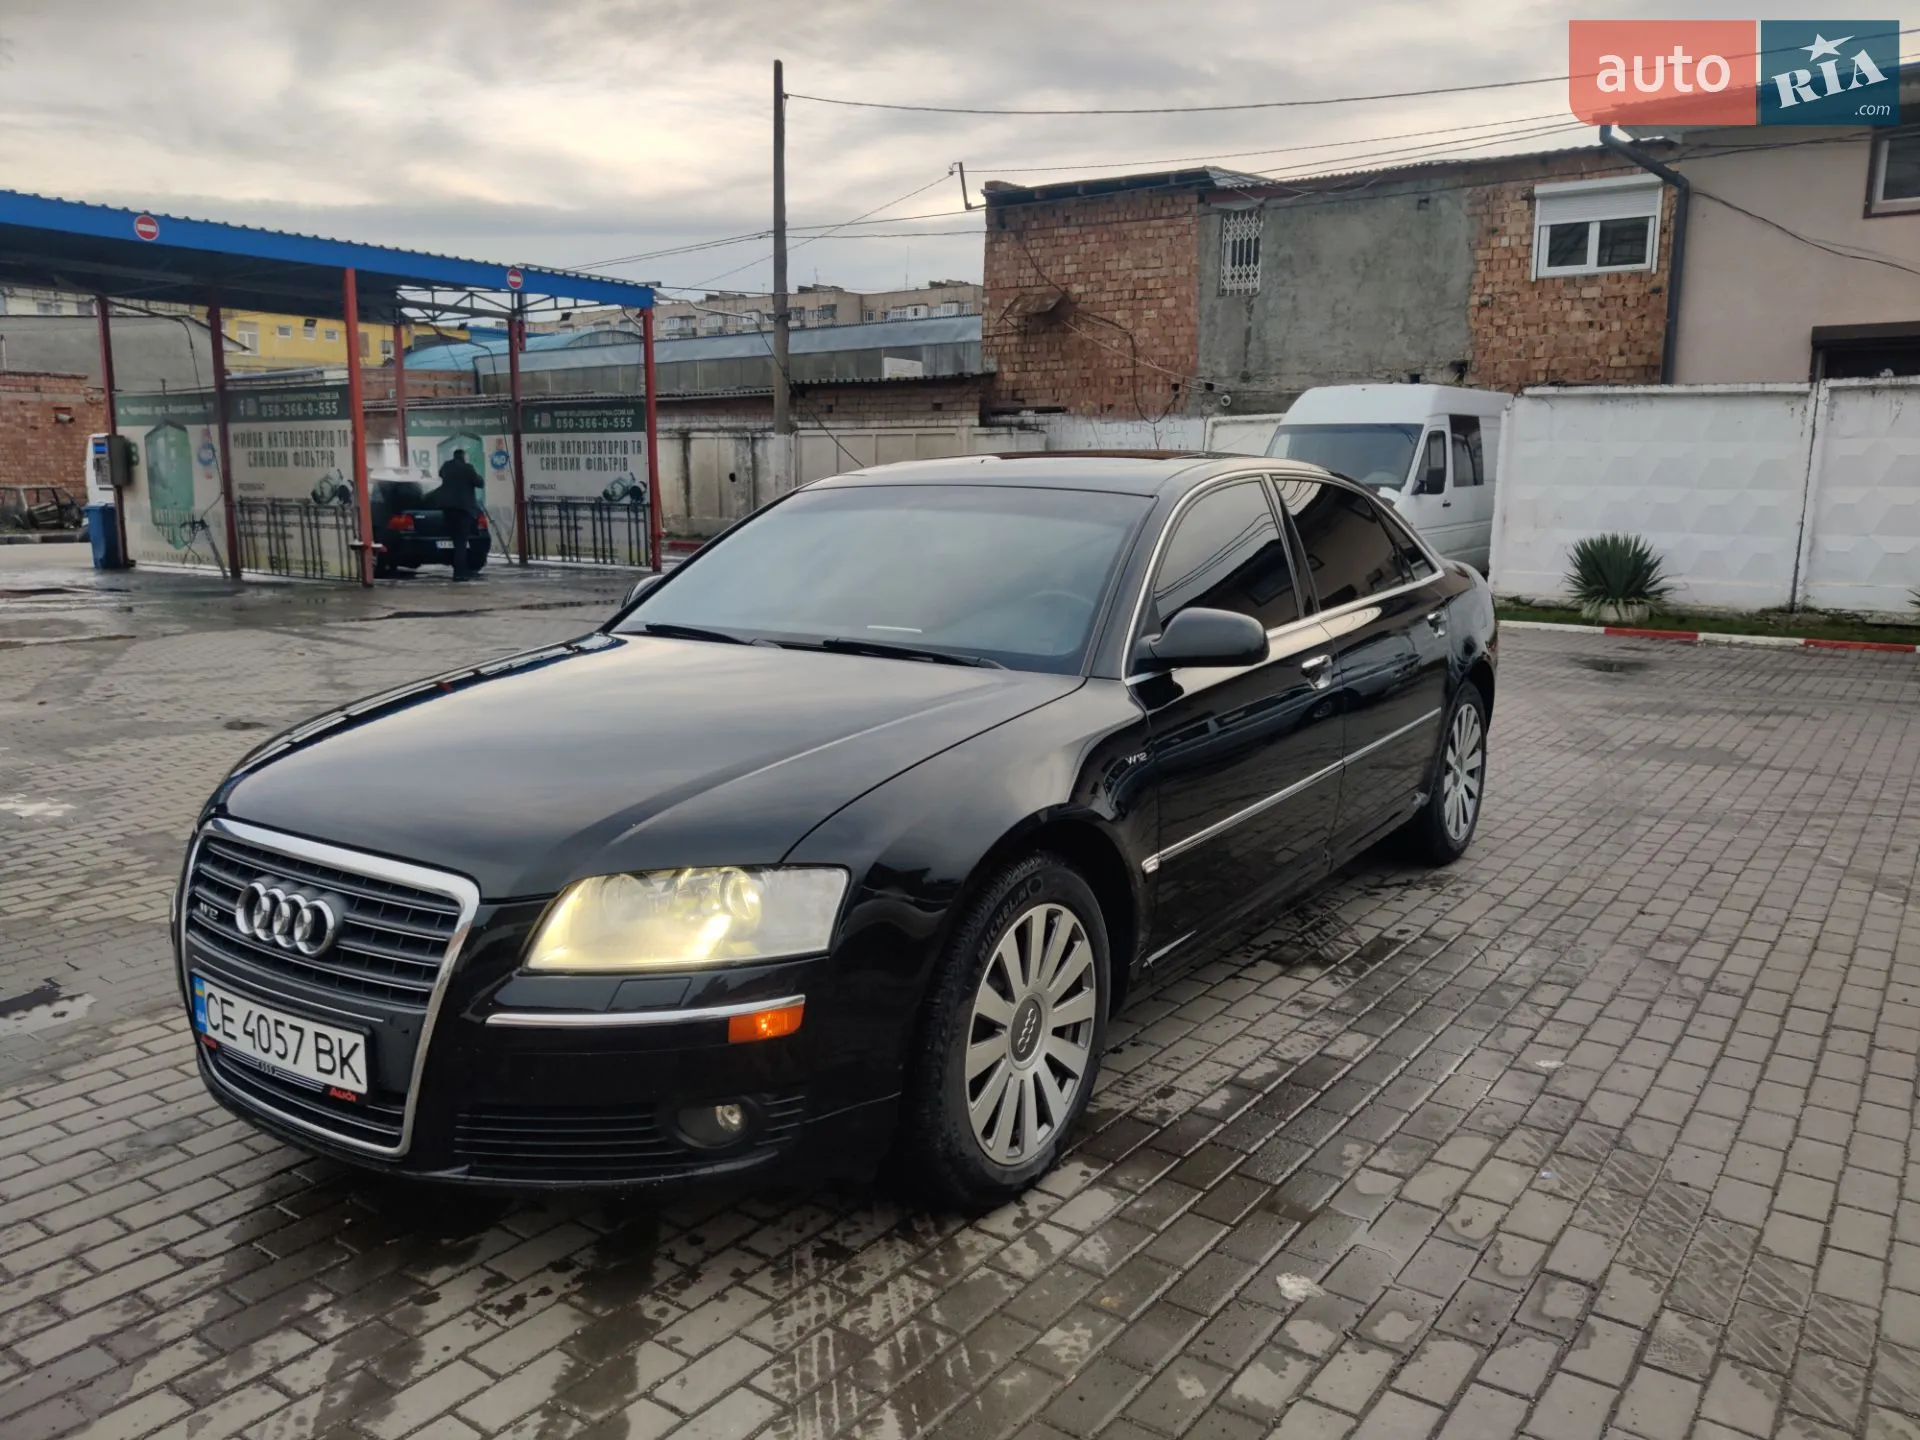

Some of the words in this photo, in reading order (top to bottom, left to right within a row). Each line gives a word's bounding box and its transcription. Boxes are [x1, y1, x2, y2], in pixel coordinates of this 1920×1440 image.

[261, 402, 338, 417] 050-366-0-555
[556, 417, 633, 429] 050-366-0-555
[1125, 752, 1148, 765] W12
[206, 993, 237, 1041] CE
[243, 1010, 304, 1065] 4057
[314, 1031, 363, 1085] BK
